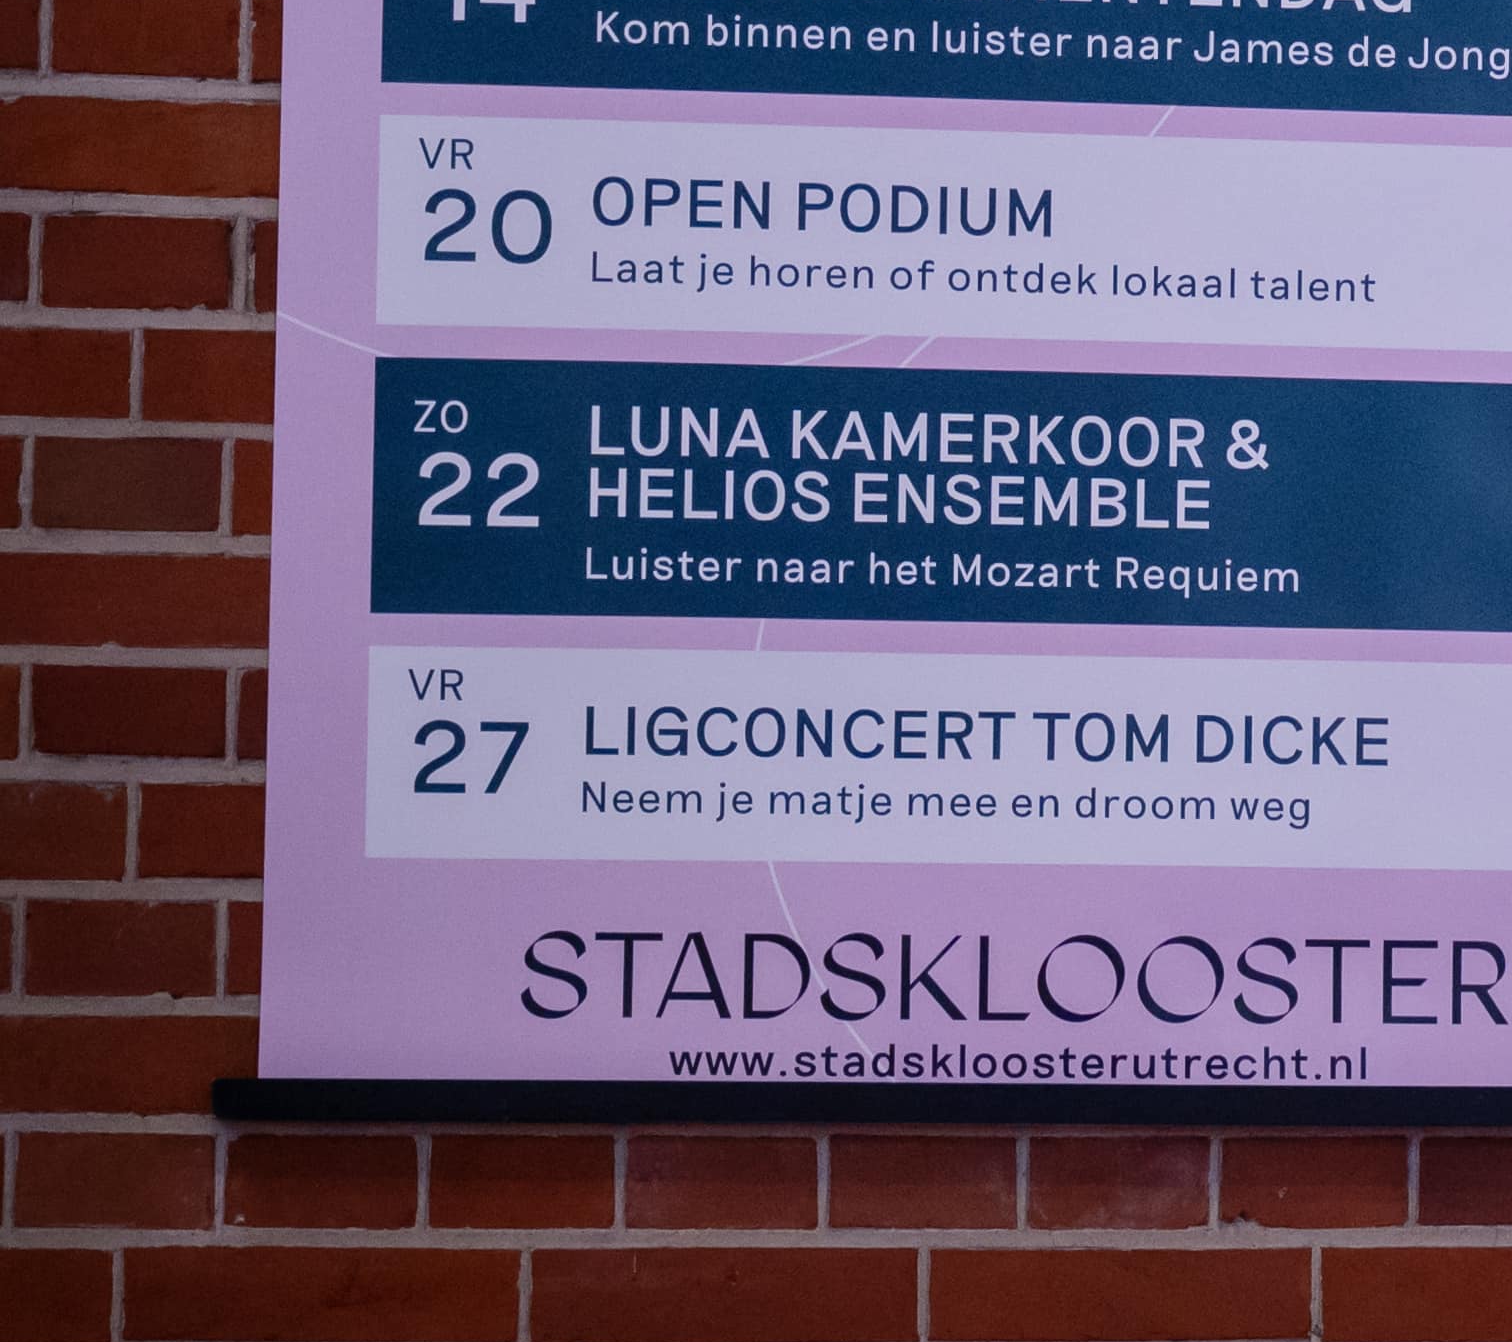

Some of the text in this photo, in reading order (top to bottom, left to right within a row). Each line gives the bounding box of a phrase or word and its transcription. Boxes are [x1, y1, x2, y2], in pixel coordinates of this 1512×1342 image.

[596, 10, 1510, 80] Kom binnen en luister naar James de Jong
[418, 137, 474, 170] VR
[424, 188, 553, 265] 20
[592, 176, 1052, 238] OPEN PODIUM
[591, 250, 1376, 303] Laat je horen of ontdek lokaal talent
[413, 399, 469, 434] ZO
[590, 404, 1269, 470] LUNA KAMERKOOR &
[418, 451, 540, 528] 22
[589, 467, 1211, 530] HELIOS ENSEMBLE
[585, 546, 1299, 599] Luister naar het Mozart Requiem
[408, 668, 464, 701] VR
[413, 719, 530, 794] 27
[585, 705, 1389, 767] LIGCONCERT TOM DICKE
[582, 781, 1310, 830] Neem je matje mee en droom weg
[520, 930, 1509, 1025] STADSKLOOSTER
[669, 1043, 1367, 1080] www.stadskloosterutrecht.nl
